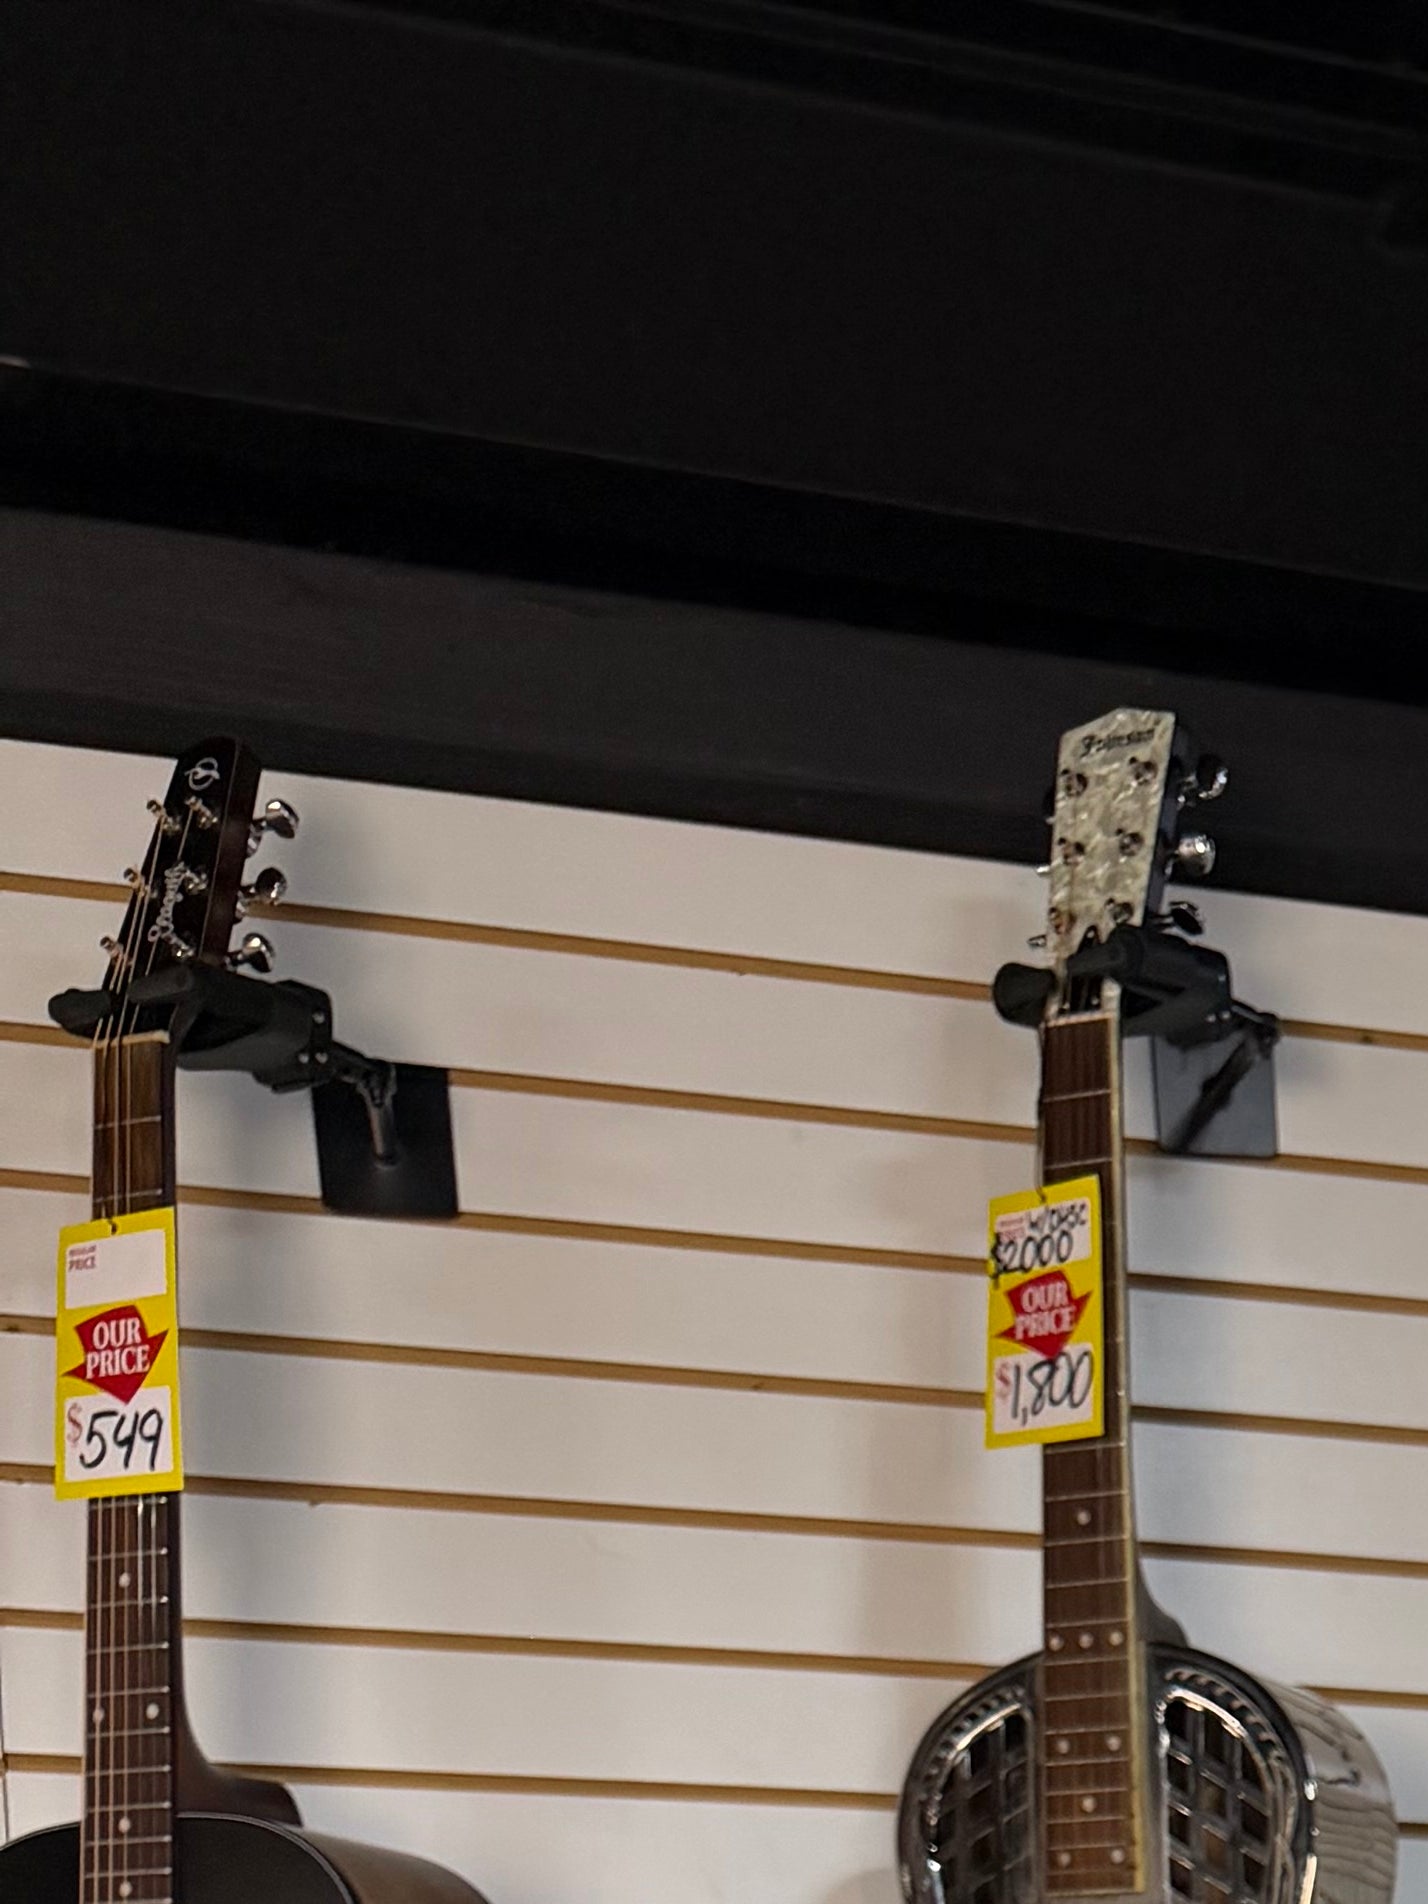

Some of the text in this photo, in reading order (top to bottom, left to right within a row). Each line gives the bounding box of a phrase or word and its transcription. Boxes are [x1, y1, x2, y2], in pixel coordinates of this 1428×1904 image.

[1020, 1281, 1069, 1315] OUR
[92, 1317, 142, 1351] OUR
[1014, 1305, 1077, 1341] PRICE
[86, 1344, 151, 1380] PRICE
